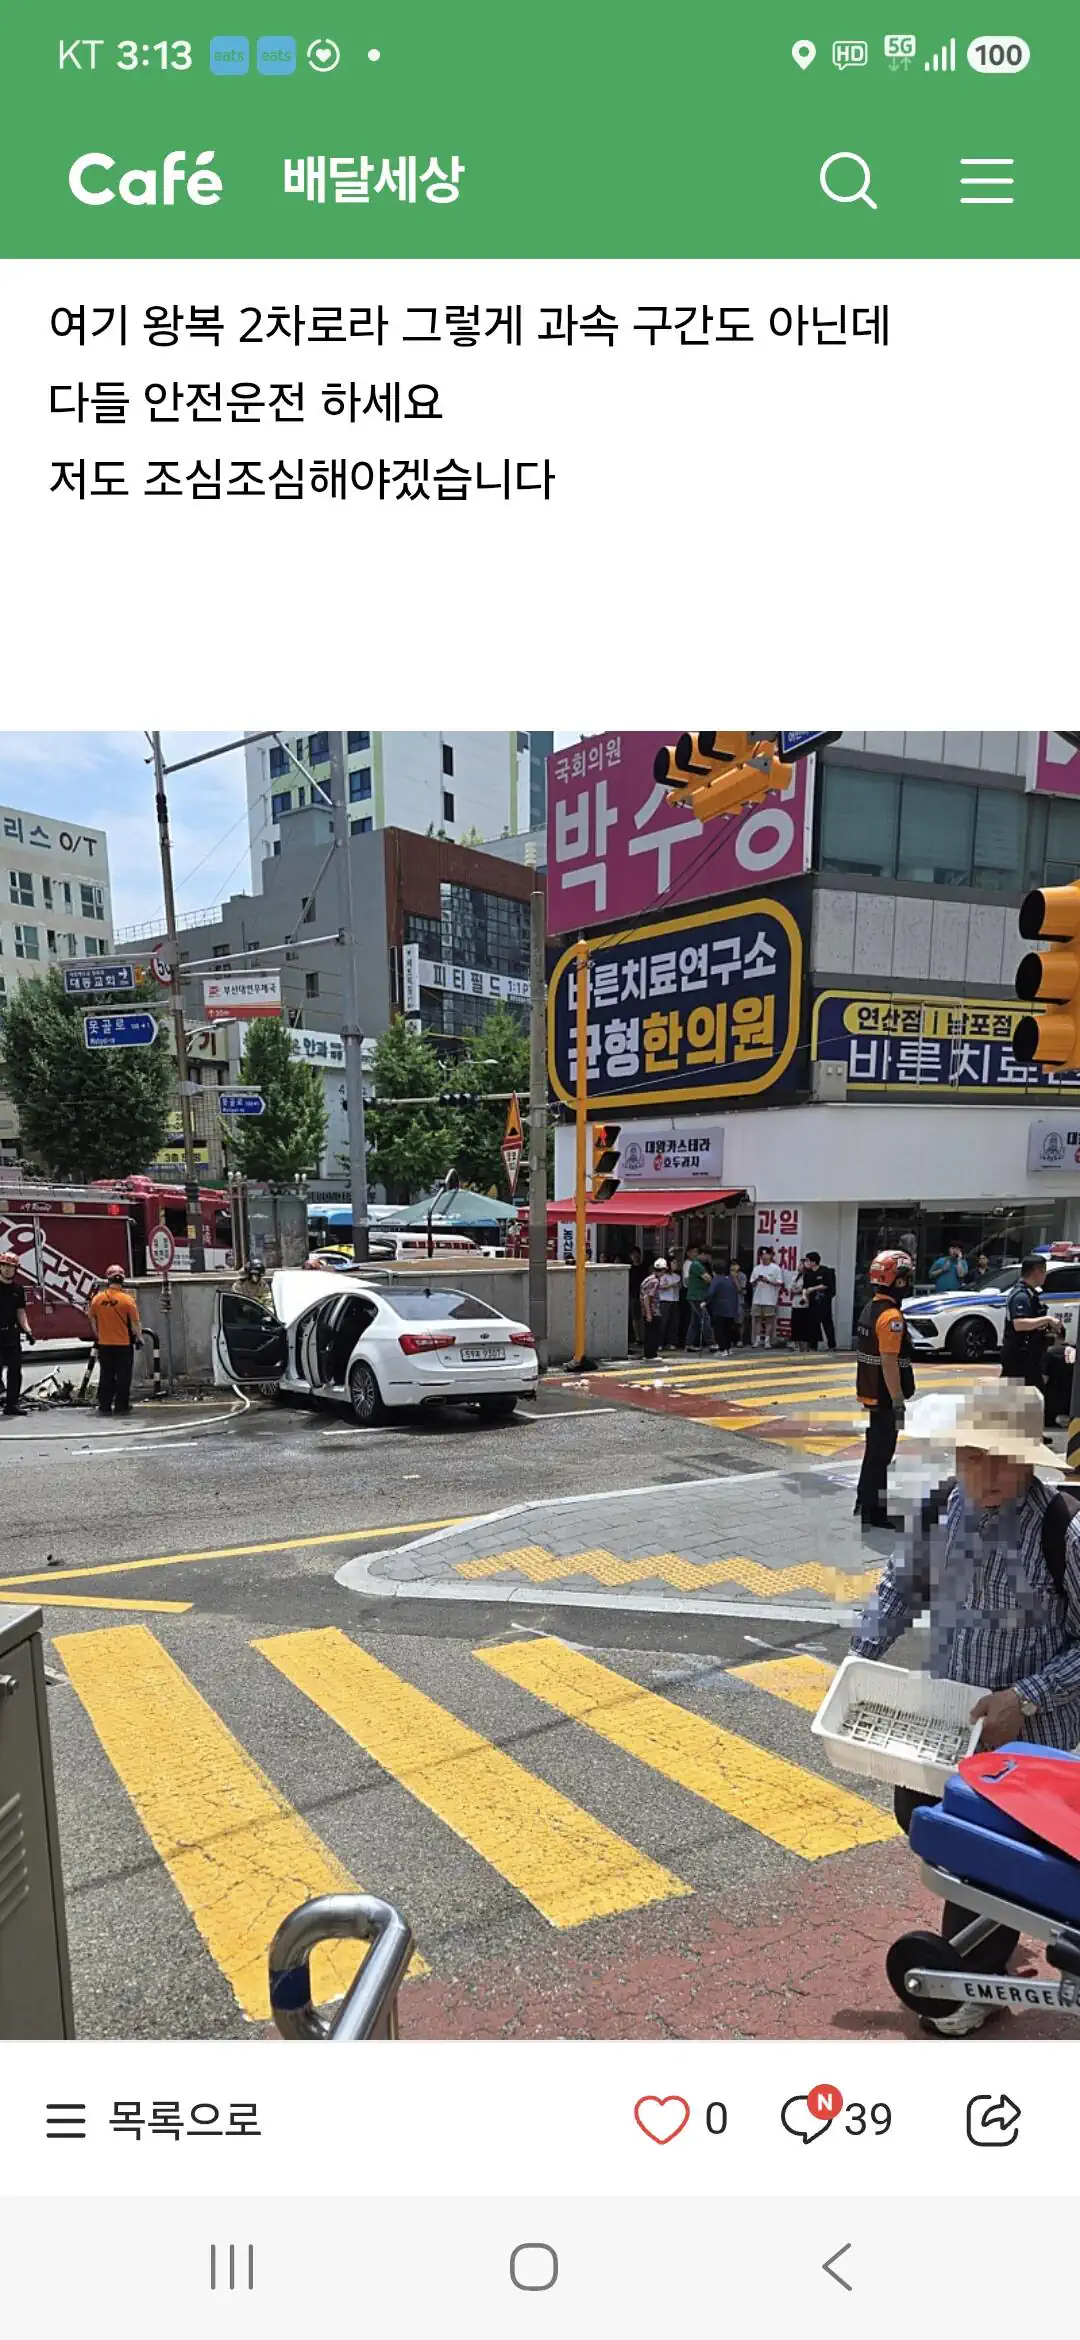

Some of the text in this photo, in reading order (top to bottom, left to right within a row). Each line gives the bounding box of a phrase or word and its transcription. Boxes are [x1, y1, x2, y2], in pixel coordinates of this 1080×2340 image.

[554, 735, 622, 785] 국회의원
[59, 831, 98, 857] O/T
[432, 964, 502, 997] 피티필드
[857, 1007, 922, 1034] 연산점
[567, 994, 777, 1082] 균형한의원
[848, 1038, 1080, 1086] 바른치료
[757, 1209, 799, 1235] 과일
